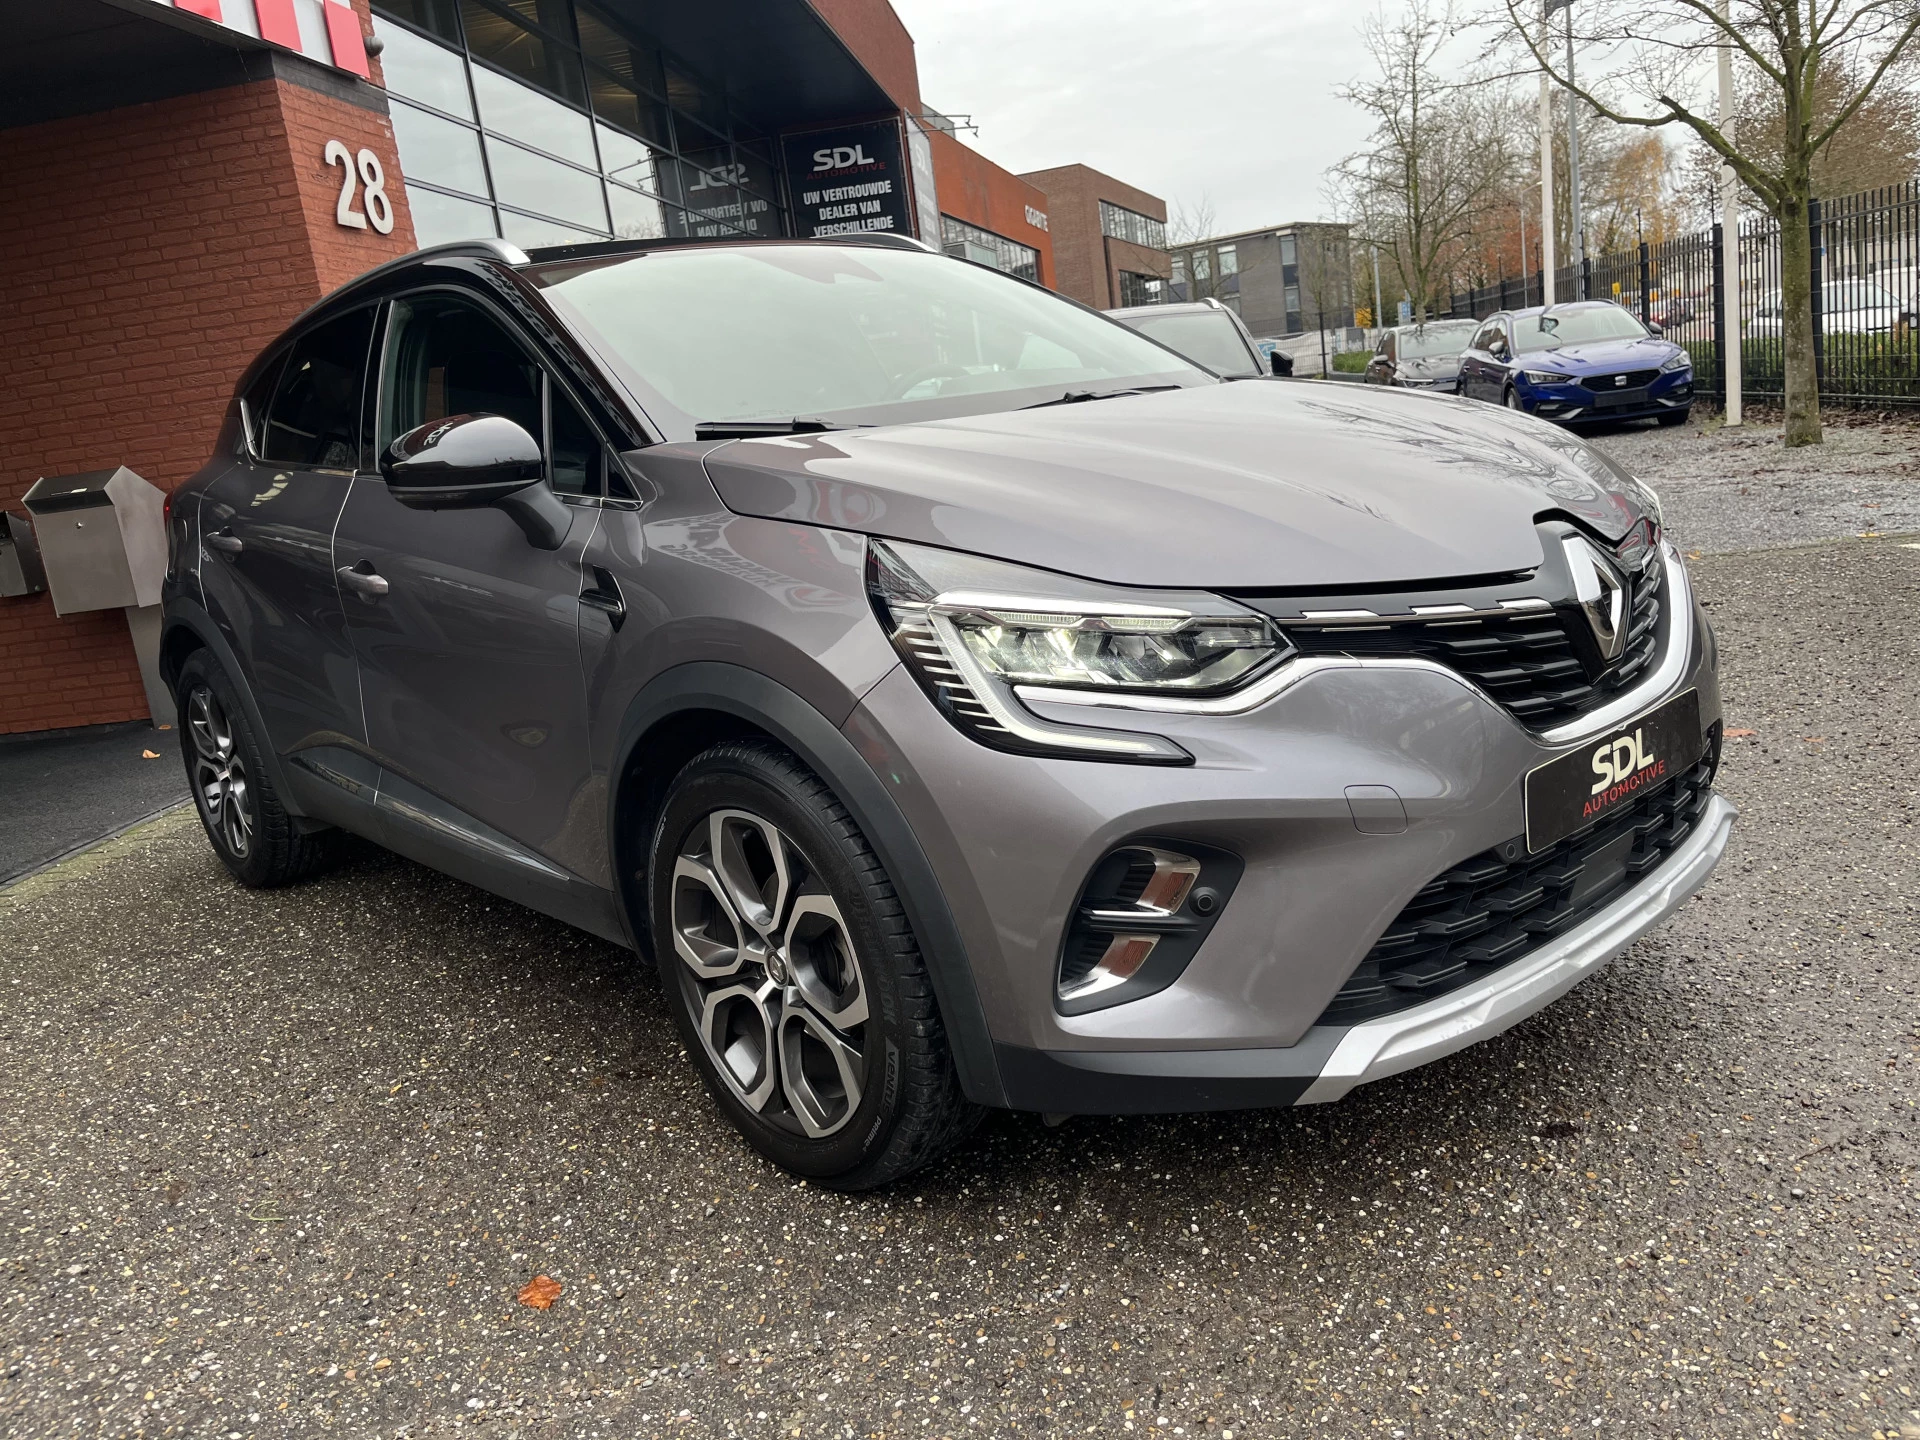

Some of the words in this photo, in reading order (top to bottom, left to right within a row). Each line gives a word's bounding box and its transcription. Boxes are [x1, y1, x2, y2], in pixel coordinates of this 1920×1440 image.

[805, 161, 886, 181] AUTOMOTIVE
[812, 144, 875, 172] SDL
[325, 139, 394, 235] 28
[803, 191, 820, 205] UW
[822, 180, 892, 203] VERTROUWDE
[818, 203, 858, 221] DEALER
[859, 200, 881, 216] VAN
[813, 215, 894, 237] VERSCHILLENDE
[1591, 727, 1655, 795] SDL
[1582, 759, 1665, 818] AUTOMOTIVE
